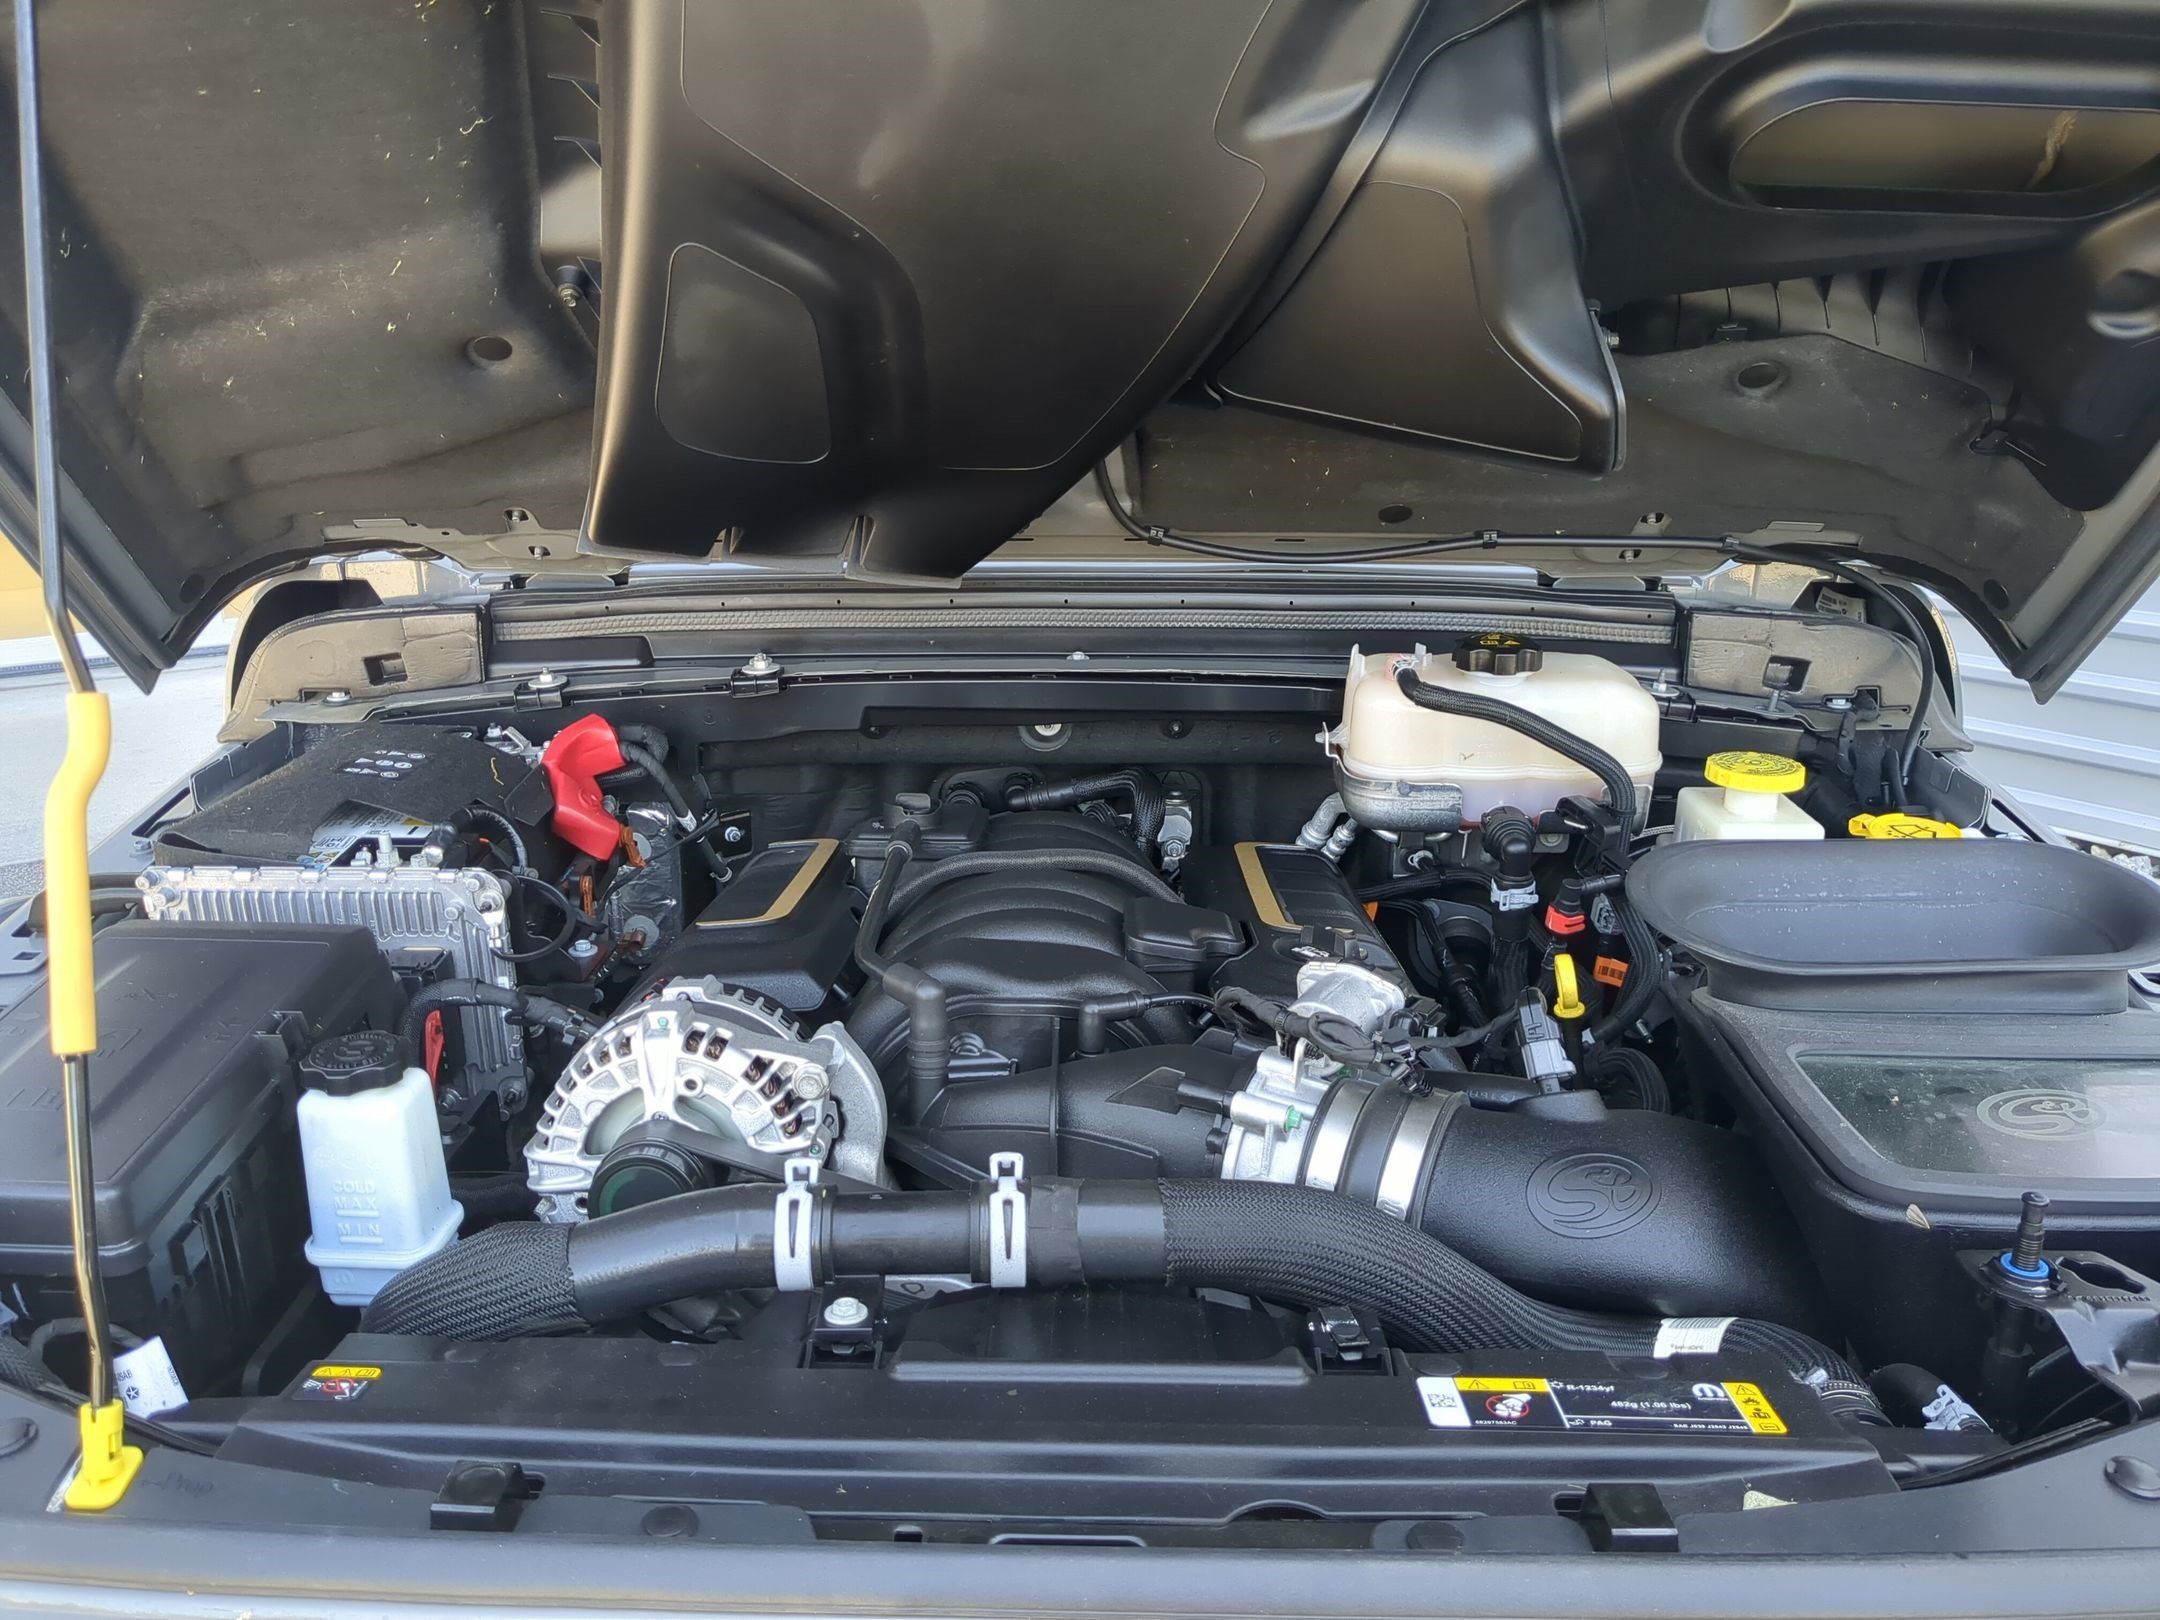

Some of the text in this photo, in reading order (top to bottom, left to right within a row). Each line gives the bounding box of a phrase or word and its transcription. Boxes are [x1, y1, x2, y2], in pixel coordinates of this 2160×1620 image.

[332, 1180, 376, 1193] COLD
[335, 1196, 377, 1209] MAX
[338, 1223, 381, 1236] MIN
